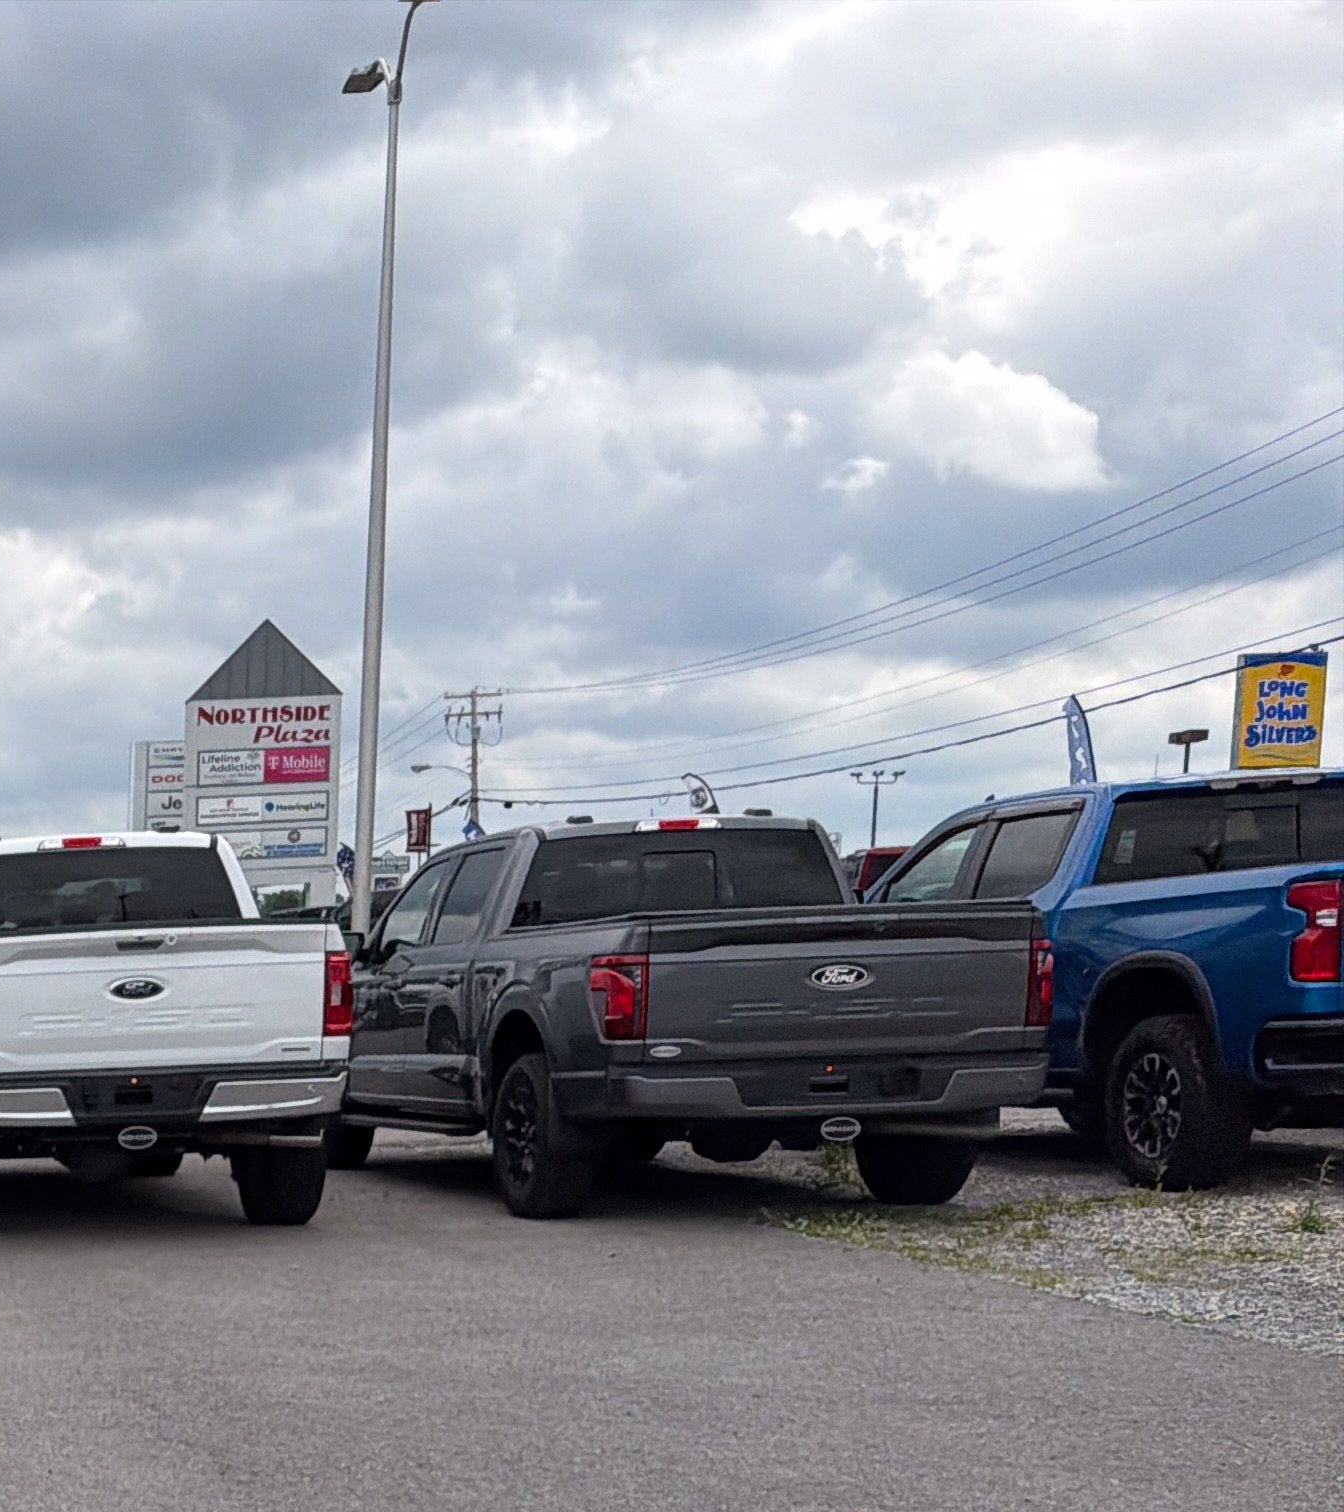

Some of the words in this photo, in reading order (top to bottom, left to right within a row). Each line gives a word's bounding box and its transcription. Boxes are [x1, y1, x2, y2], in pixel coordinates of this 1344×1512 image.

[197, 704, 330, 726] NORTHSIDE
[253, 724, 330, 744] Plaza
[202, 754, 240, 764] Lifeline
[209, 763, 261, 773] Addiction
